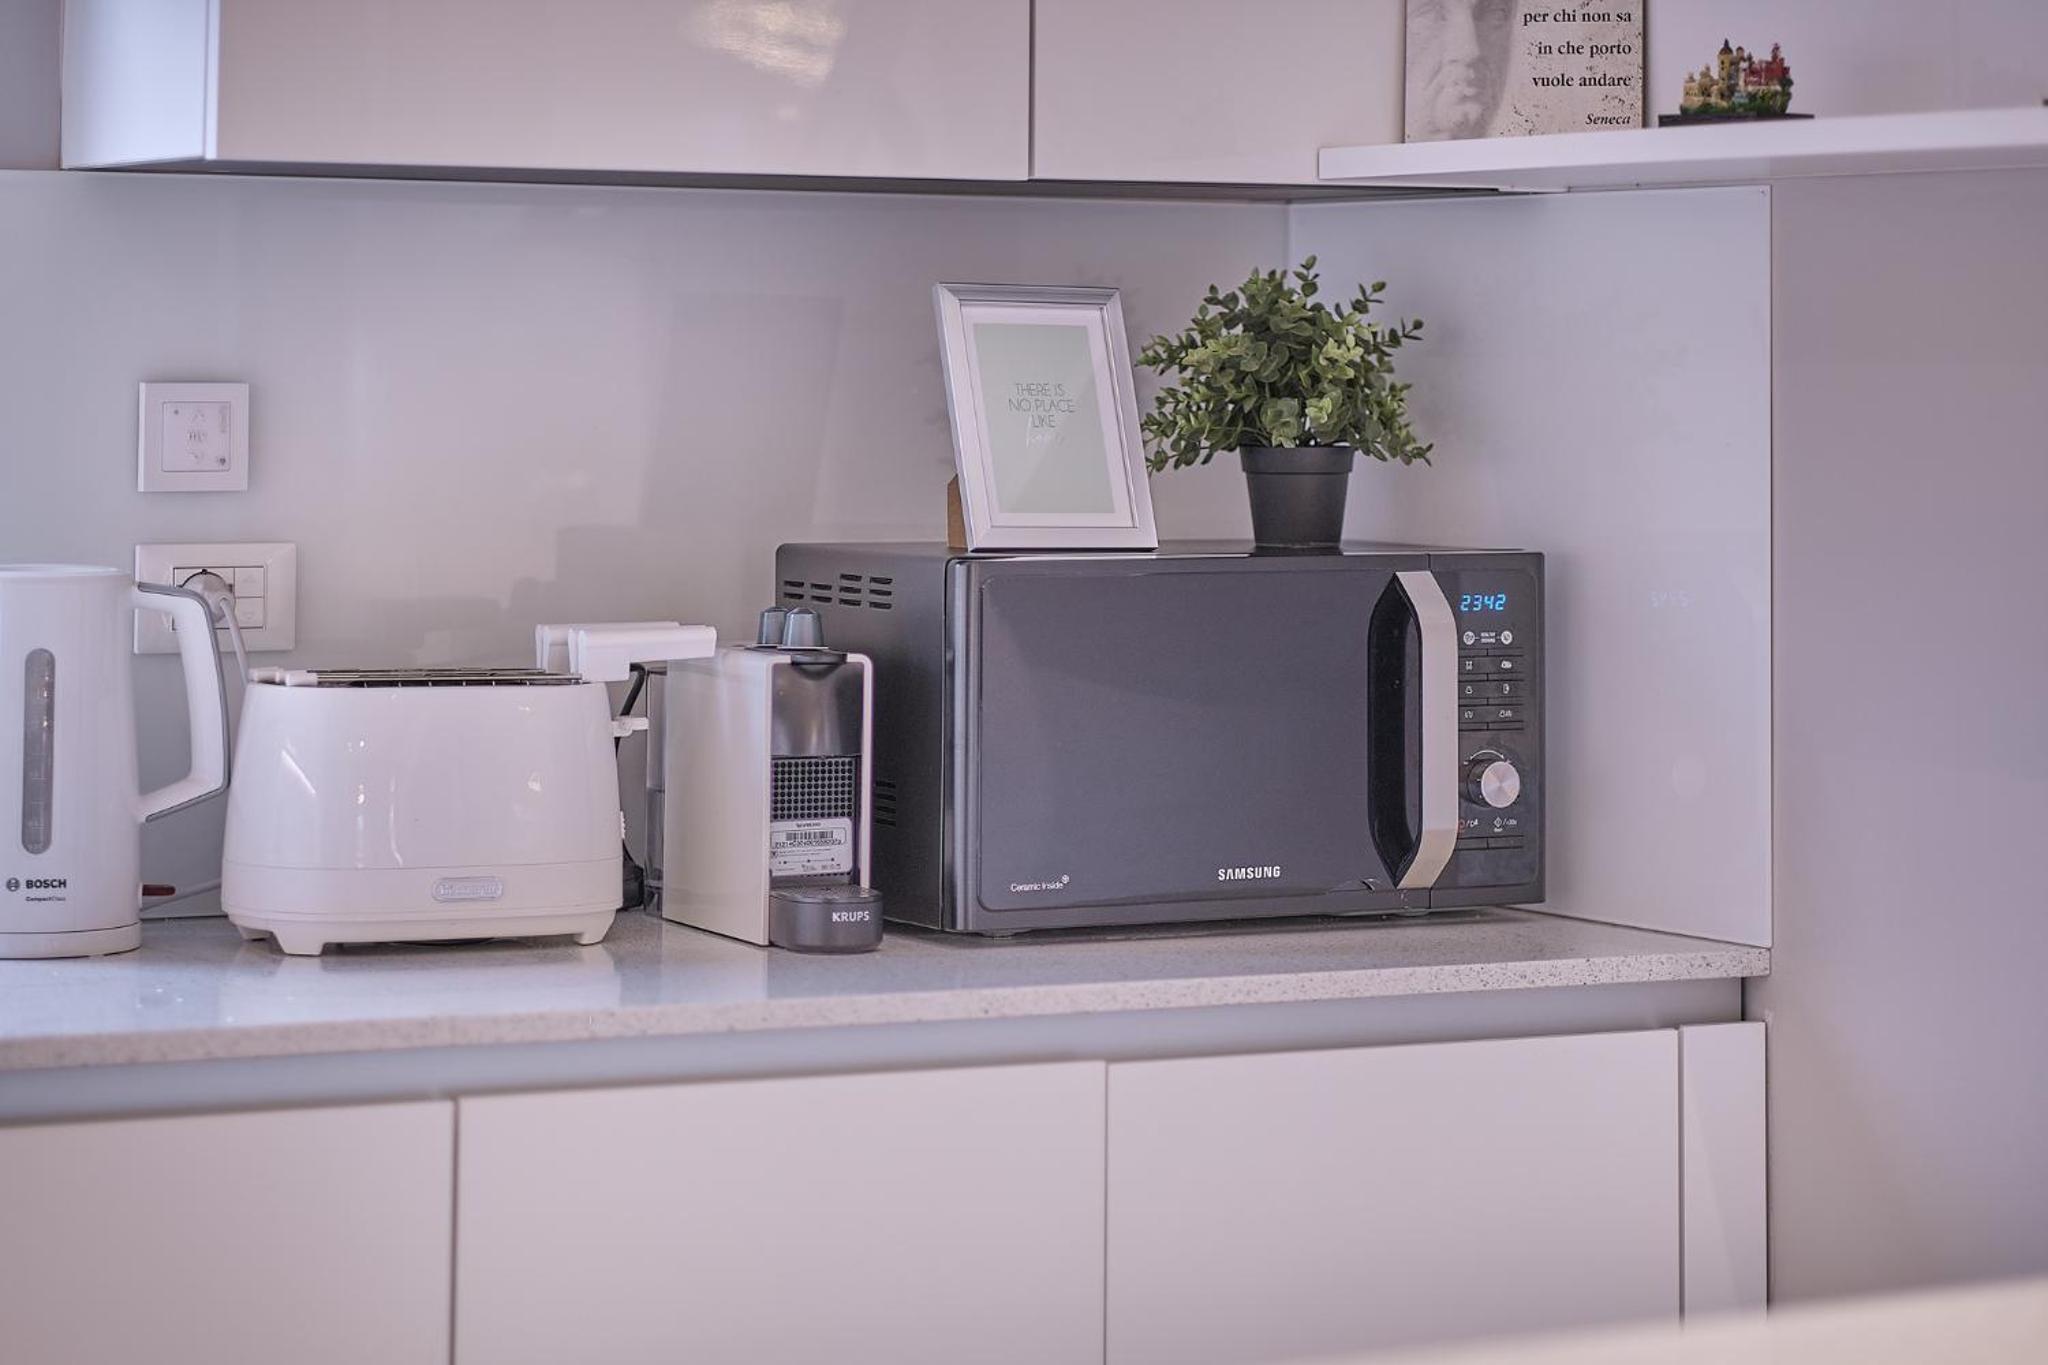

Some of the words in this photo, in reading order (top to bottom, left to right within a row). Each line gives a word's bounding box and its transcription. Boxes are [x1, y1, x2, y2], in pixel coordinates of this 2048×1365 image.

[1523, 11, 1549, 26] per
[1553, 9, 1577, 22] chi
[1582, 12, 1611, 22] non
[1616, 11, 1632, 22] sa
[1538, 41, 1552, 54] in
[1557, 41, 1585, 54] che
[1590, 43, 1632, 58] porto
[1532, 73, 1574, 87] vuole
[1579, 73, 1632, 87] andare
[1585, 113, 1631, 125] Seneca
[1015, 383, 1051, 397] THERE
[1054, 383, 1065, 397] IS
[1008, 398, 1031, 412] NO
[1034, 399, 1076, 413] PLACE
[1031, 414, 1056, 428] LIKE
[1460, 594, 1507, 611] 2342
[1218, 866, 1281, 881] SAMSUNG
[25, 879, 67, 889] BOSCH
[832, 911, 870, 922] KRUPS
